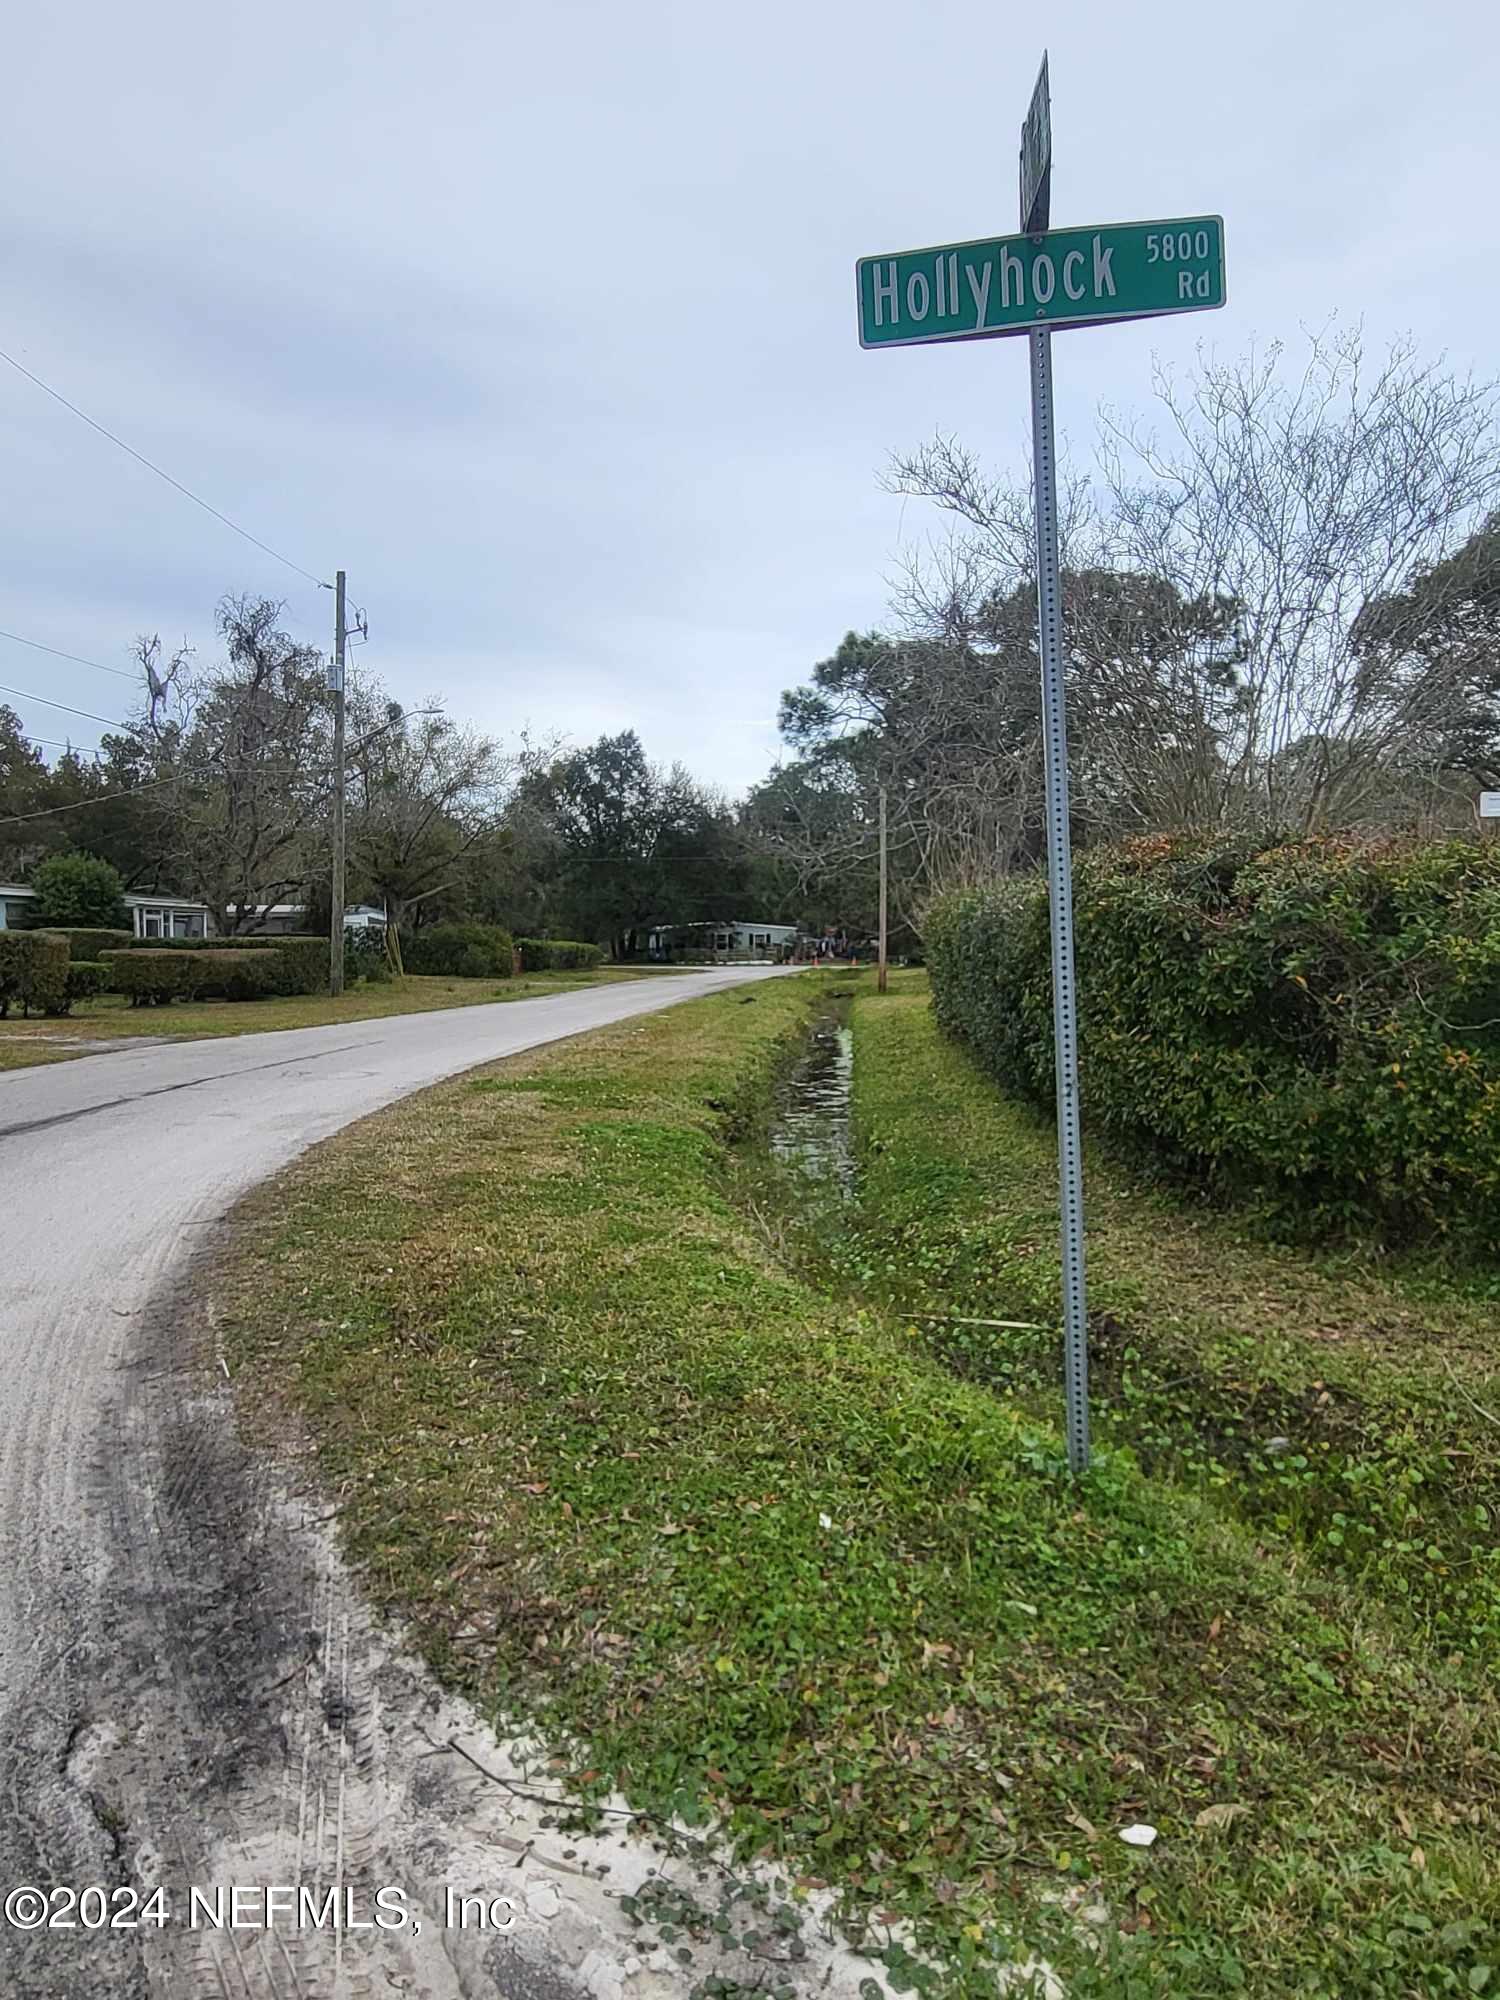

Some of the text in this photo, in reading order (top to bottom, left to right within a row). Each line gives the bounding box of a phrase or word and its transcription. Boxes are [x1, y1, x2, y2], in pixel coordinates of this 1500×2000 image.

[1146, 231, 1210, 263] 5800
[872, 234, 1117, 329] Hollyhock
[1178, 270, 1210, 300] Rd
